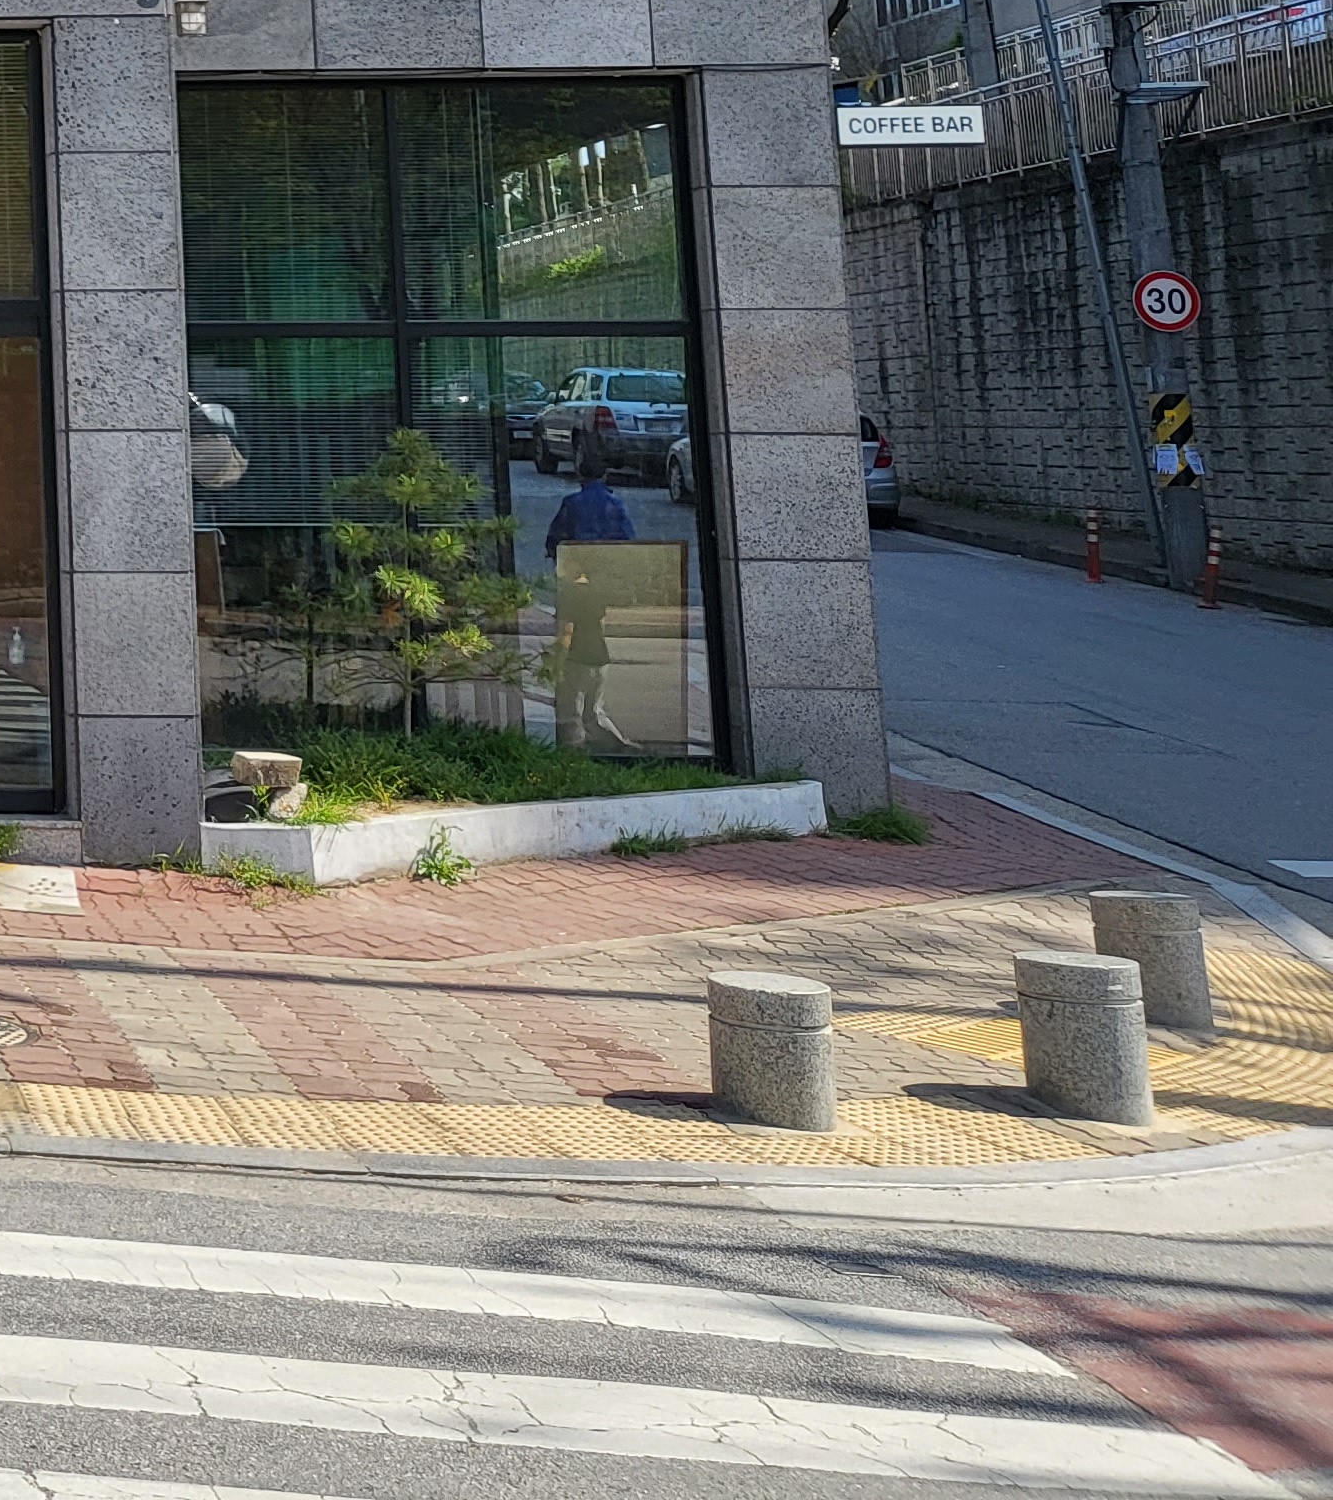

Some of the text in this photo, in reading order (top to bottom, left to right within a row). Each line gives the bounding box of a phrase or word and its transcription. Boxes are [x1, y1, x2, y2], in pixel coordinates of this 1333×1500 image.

[848, 115, 974, 135] COFFEE BAR
[1146, 287, 1187, 315] 30
